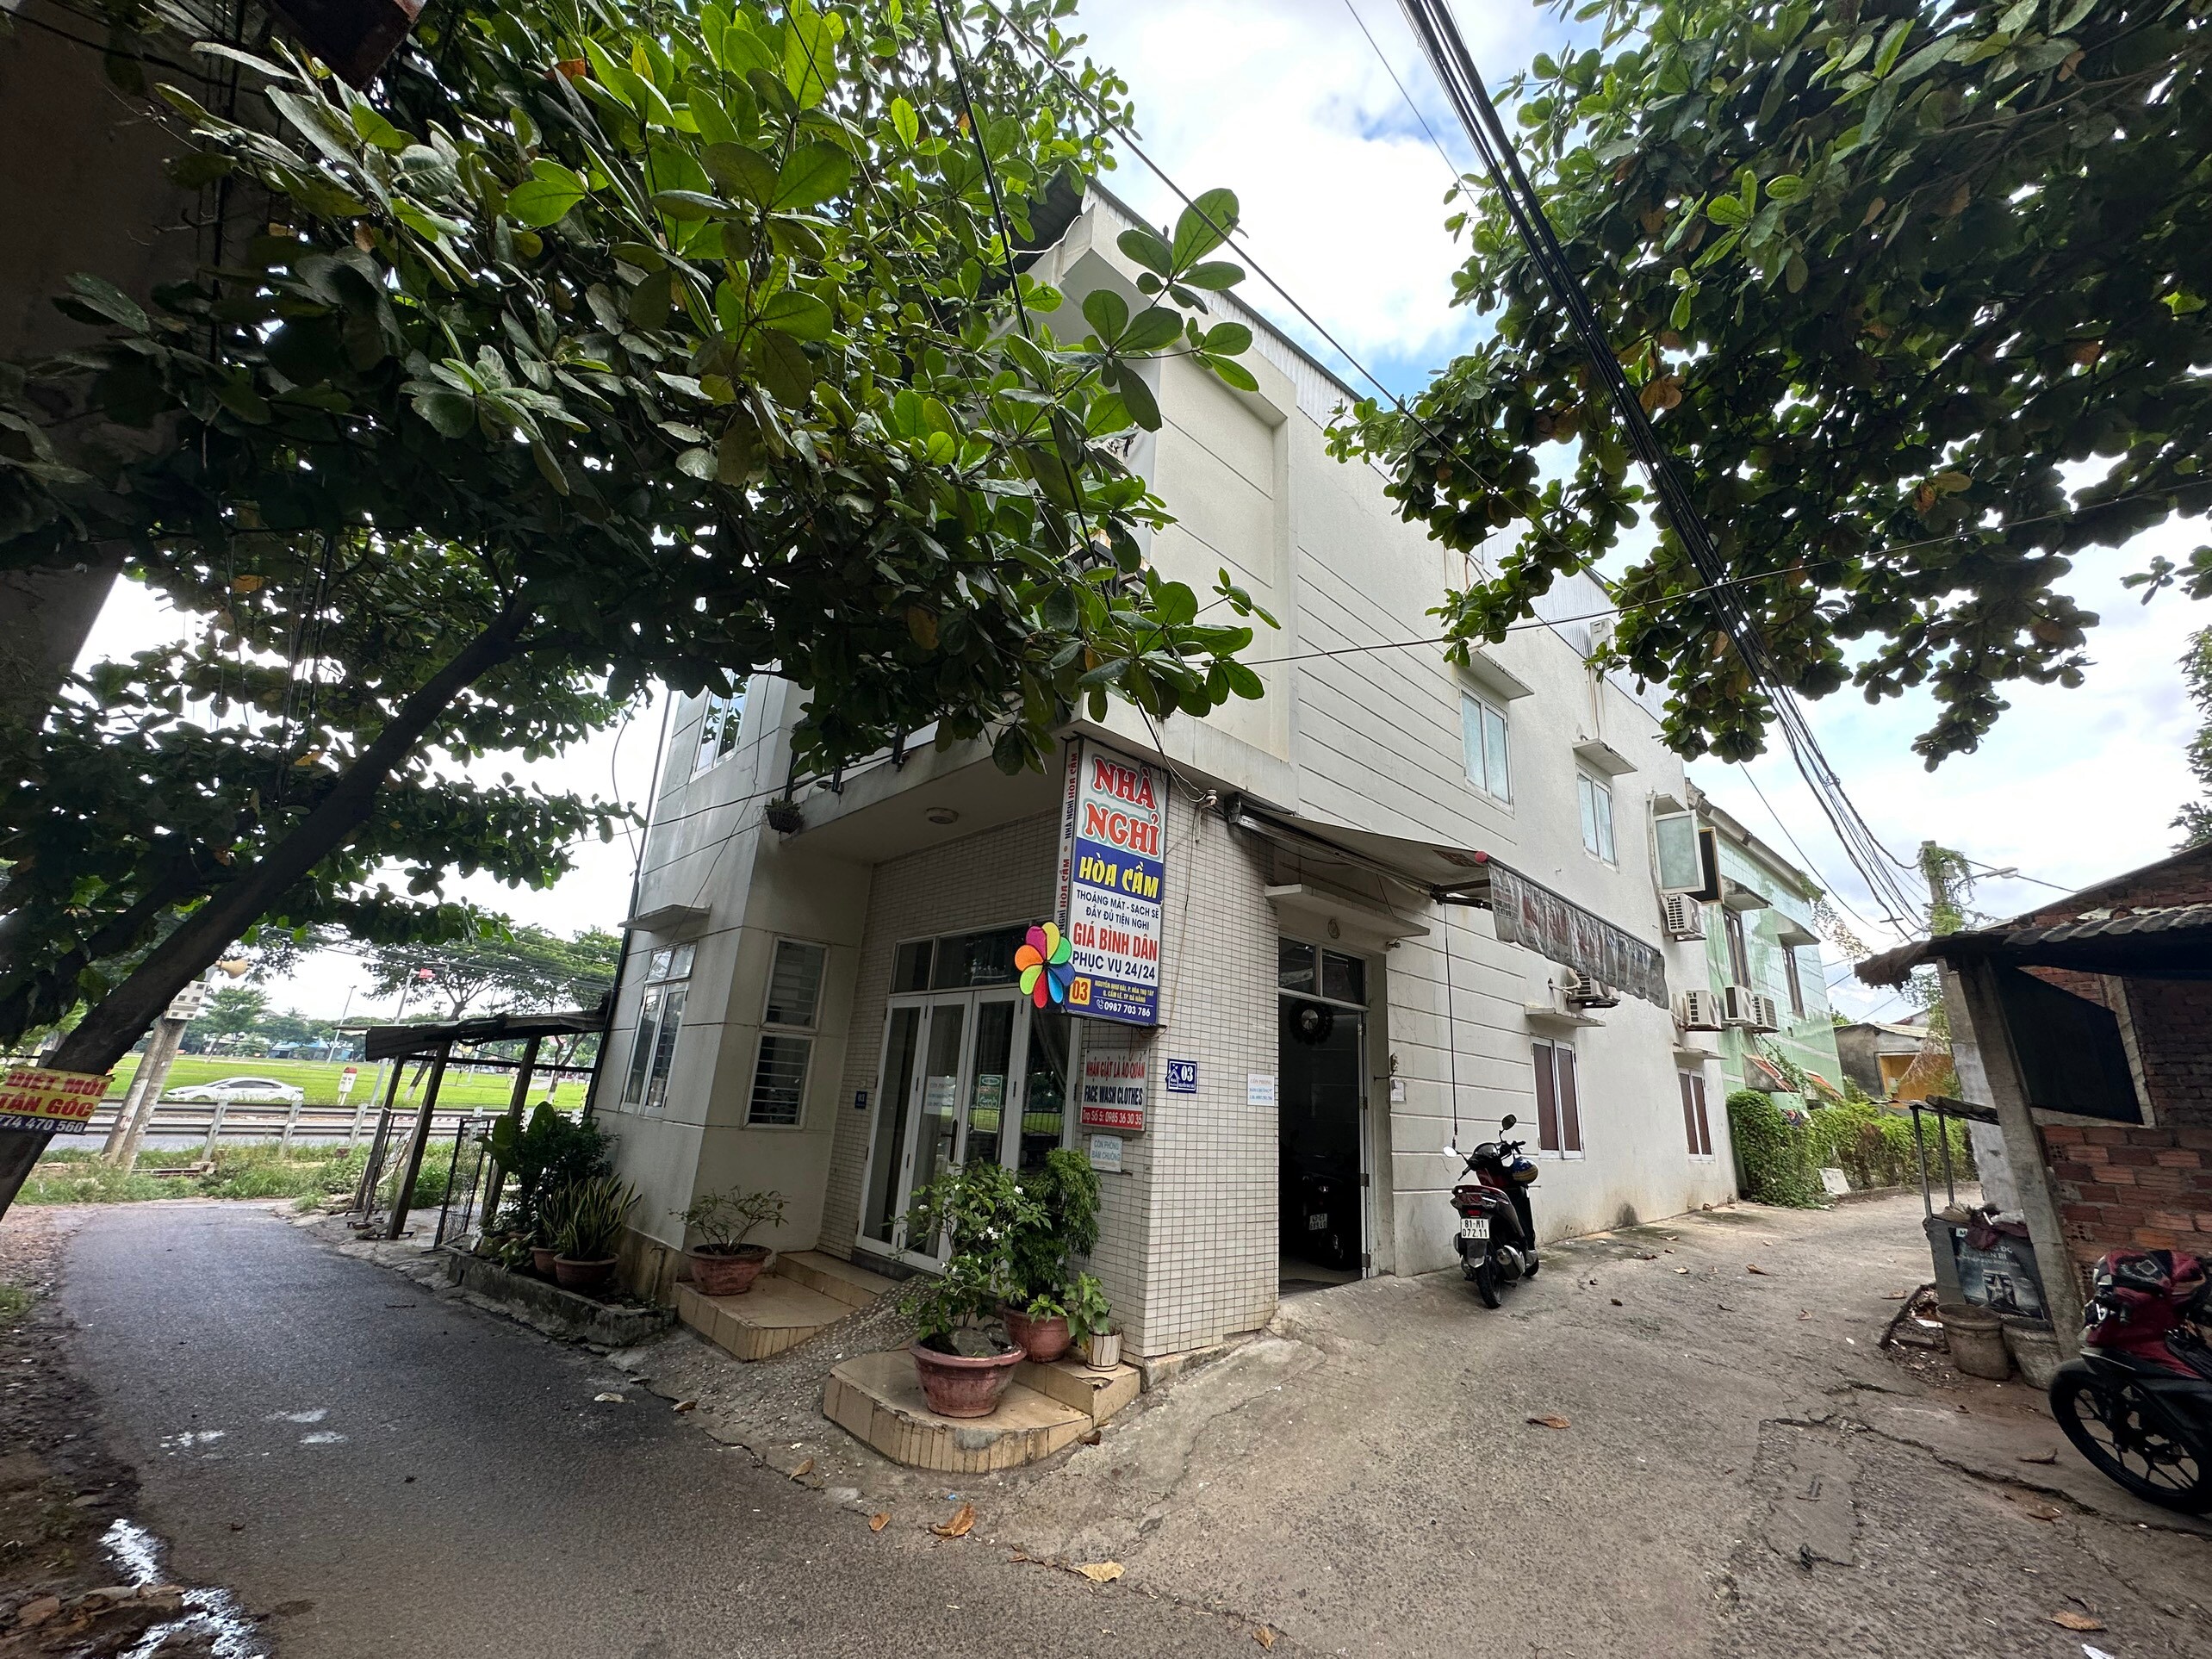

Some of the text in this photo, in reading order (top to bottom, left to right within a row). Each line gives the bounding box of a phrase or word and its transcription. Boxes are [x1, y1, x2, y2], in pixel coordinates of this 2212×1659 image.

[1094, 758, 1156, 810] NHÀ
[1085, 803, 1159, 856] NGHỈ
[1078, 852, 1159, 899] HÒA CẦM
[1077, 889, 1109, 906] THOÁNG
[1110, 898, 1126, 910] MÁT
[1130, 904, 1150, 916] SẠCH
[1103, 909, 1114, 922] ĐỦ
[1115, 912, 1130, 928] TIỆN
[1132, 917, 1150, 930] NGHI
[1073, 921, 1158, 961] GIÁ BÌNH DÂN
[1072, 950, 1155, 980] PHỤC VỤ 24/24
[1072, 980, 1088, 1001] 03
[1103, 1001, 1151, 1017] 0987 703 786
[1113, 1055, 1121, 1078] LÀ
[1181, 1066, 1193, 1082] 03
[5, 1071, 60, 1092] DIỆT
[1084, 1084, 1143, 1106] FACE WASH CLOTHES
[46, 1096, 94, 1117] GỐC
[26, 1117, 55, 1131] 470
[55, 1121, 85, 1134] 560
[1090, 1109, 1099, 1122] Số
[1119, 1112, 1127, 1124] 36
[1127, 1113, 1134, 1125] 30
[1134, 1114, 1142, 1126] 35
